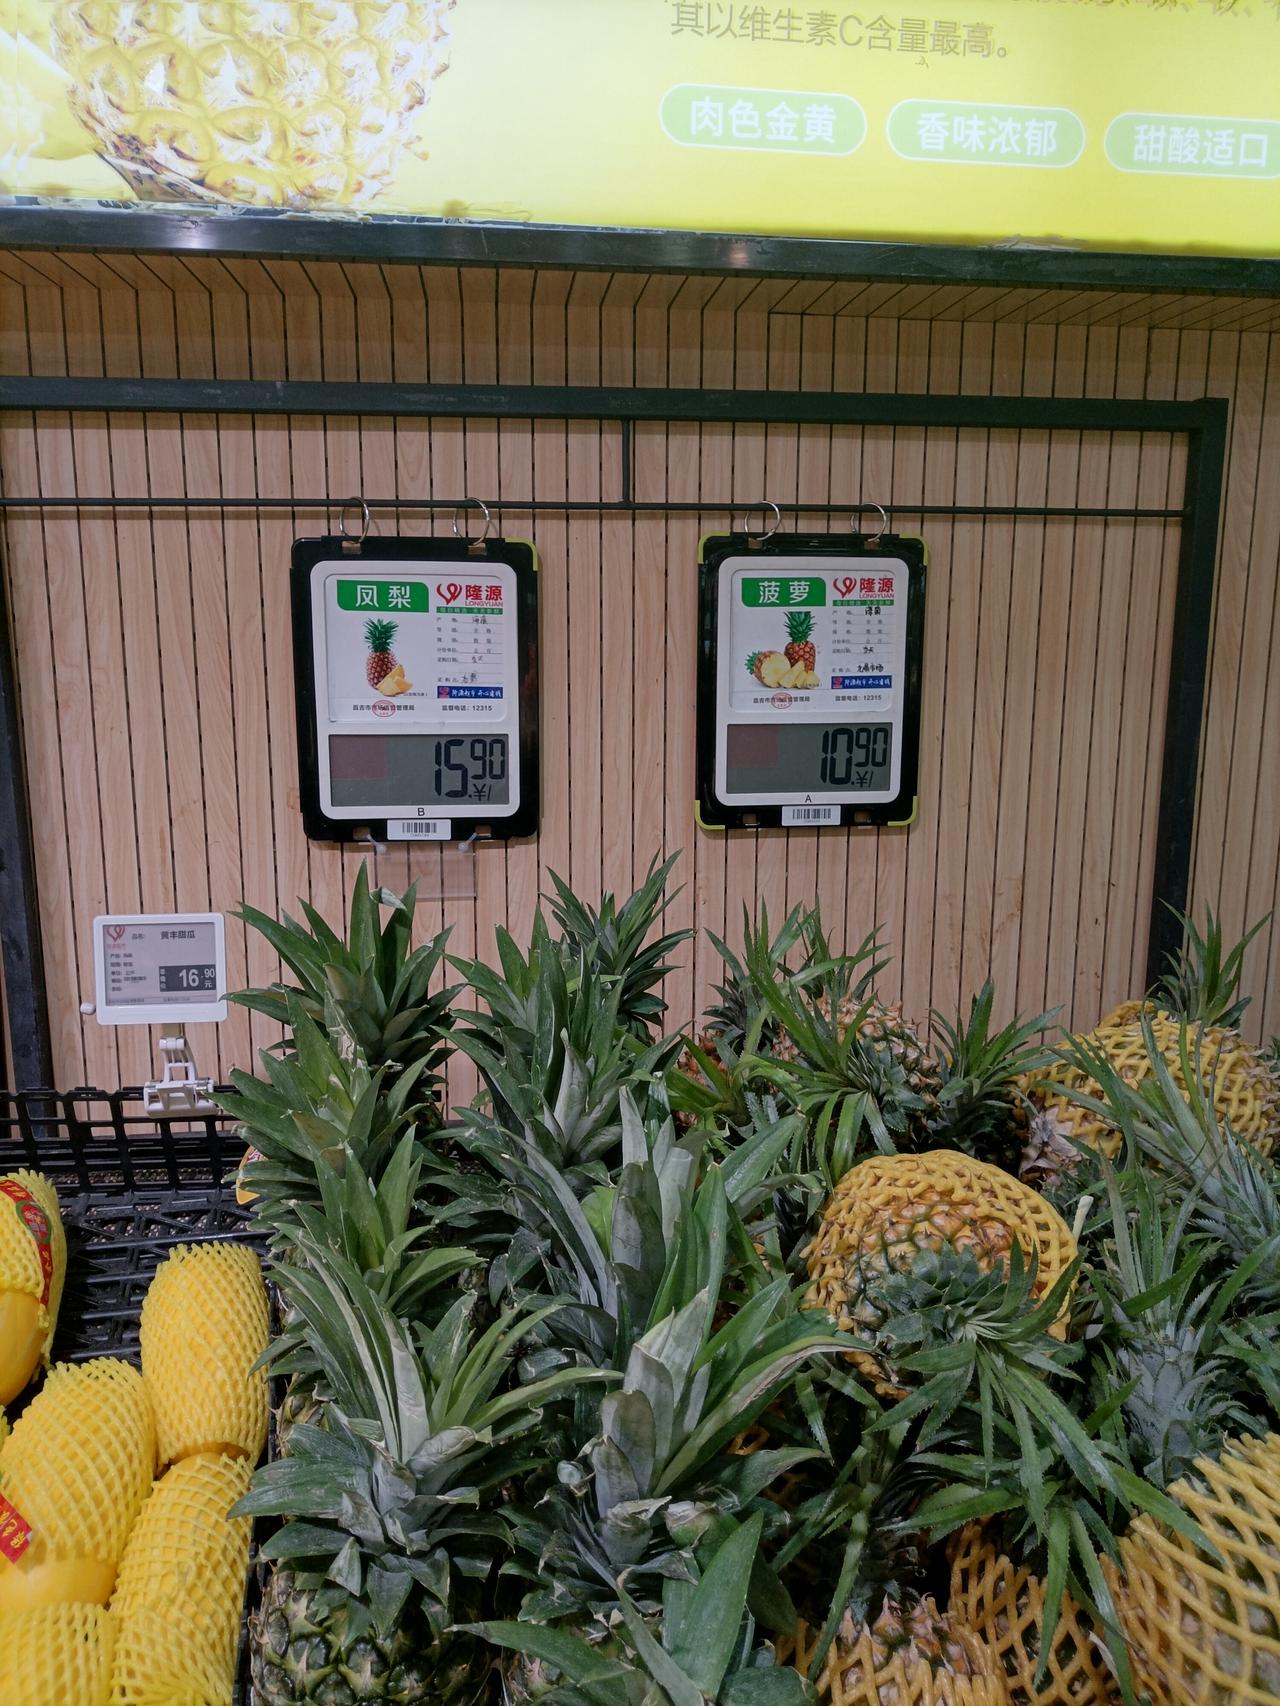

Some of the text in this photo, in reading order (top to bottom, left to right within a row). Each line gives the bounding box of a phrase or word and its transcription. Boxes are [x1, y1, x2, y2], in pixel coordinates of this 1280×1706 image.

[671, 1, 1008, 59] 其以维生素C含量最高。
[690, 95, 837, 145] 肉色金黄
[916, 111, 1058, 157] 香味浓郁
[1133, 124, 1269, 168] 甜酸适口
[355, 584, 412, 609] 凤梨
[465, 584, 503, 601] 隆源
[758, 581, 810, 604] 菠萝
[860, 577, 894, 593] 隆源
[434, 738, 506, 799] 15.90
[821, 727, 889, 786] 10.90
[804, 794, 812, 803] A
[417, 807, 425, 816] B
[204, 981, 213, 989] 元
